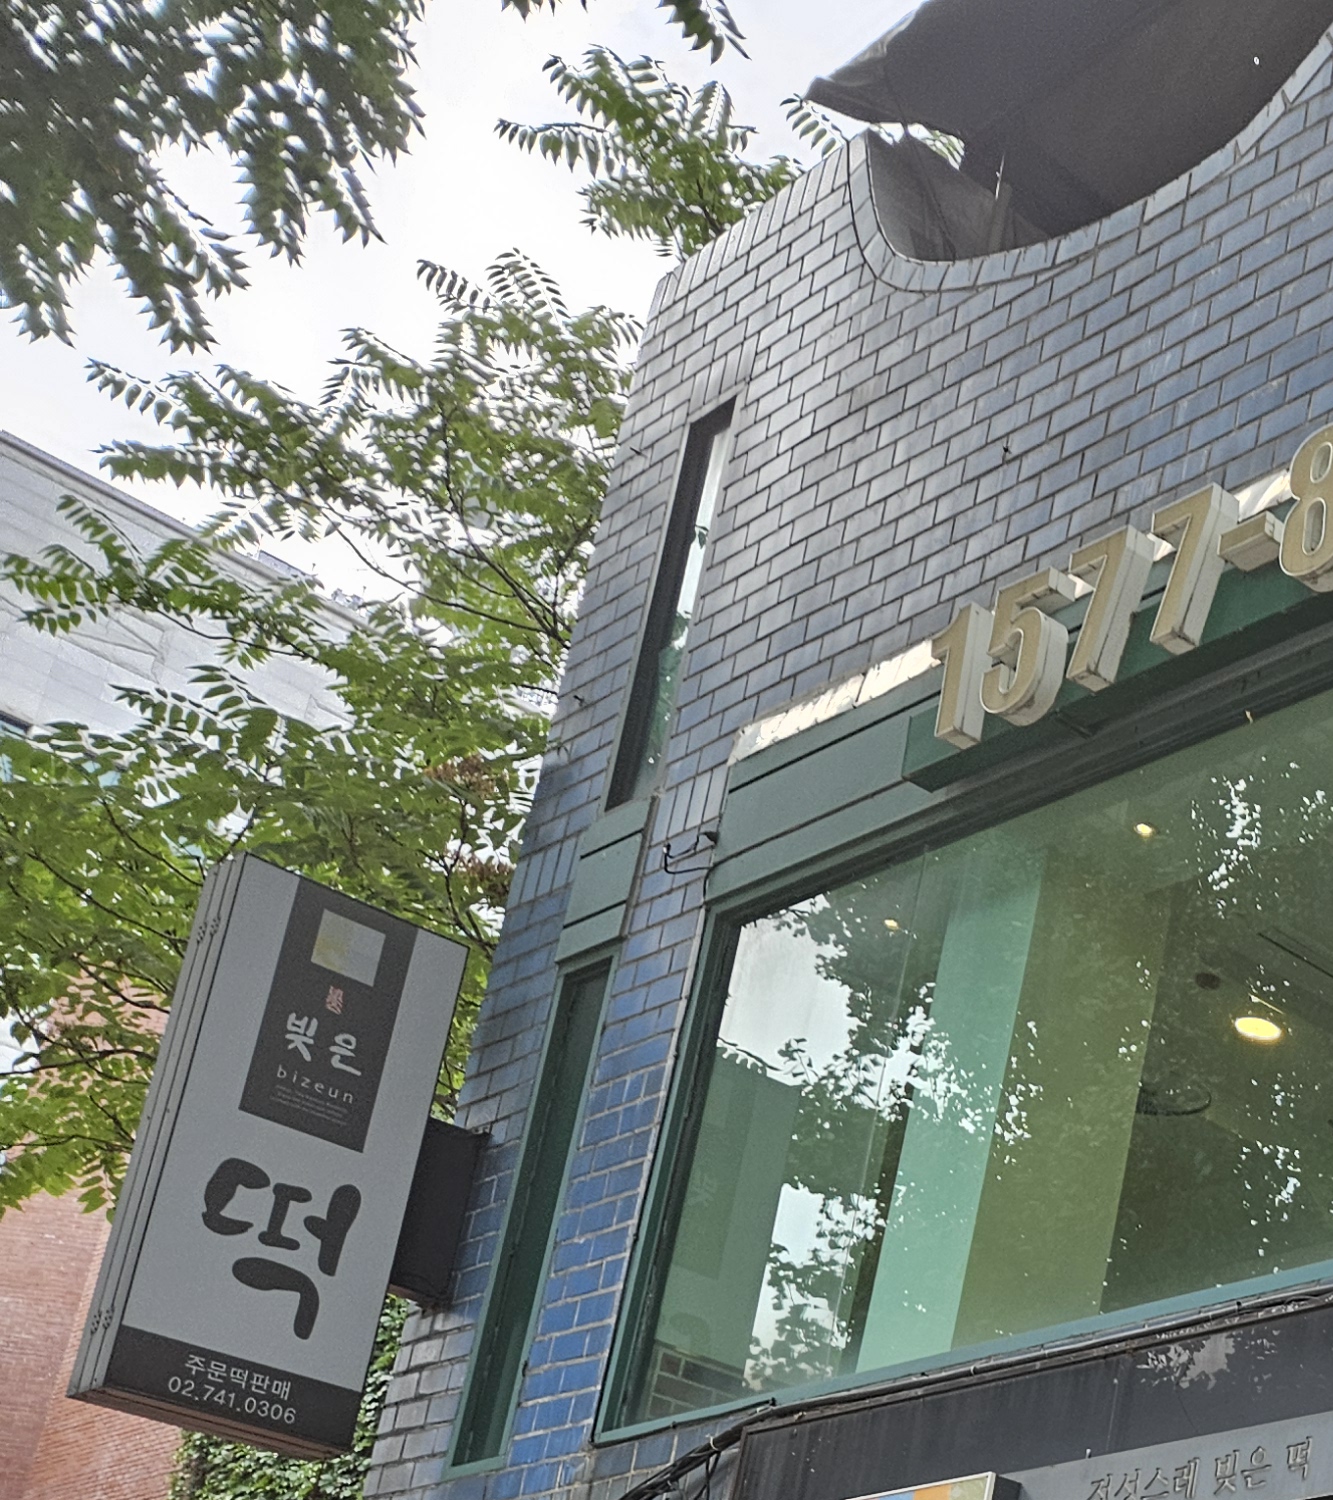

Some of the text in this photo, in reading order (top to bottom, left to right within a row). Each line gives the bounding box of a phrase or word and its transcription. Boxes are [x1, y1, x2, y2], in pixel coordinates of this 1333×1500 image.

[284, 1012, 362, 1076] 빚은
[276, 1064, 354, 1104] bizeun
[201, 1157, 362, 1341] 떡
[167, 1376, 297, 1425] 02.741.0306
[184, 1354, 291, 1401] 주문떡판매
[1285, 1436, 1314, 1482] 떡
